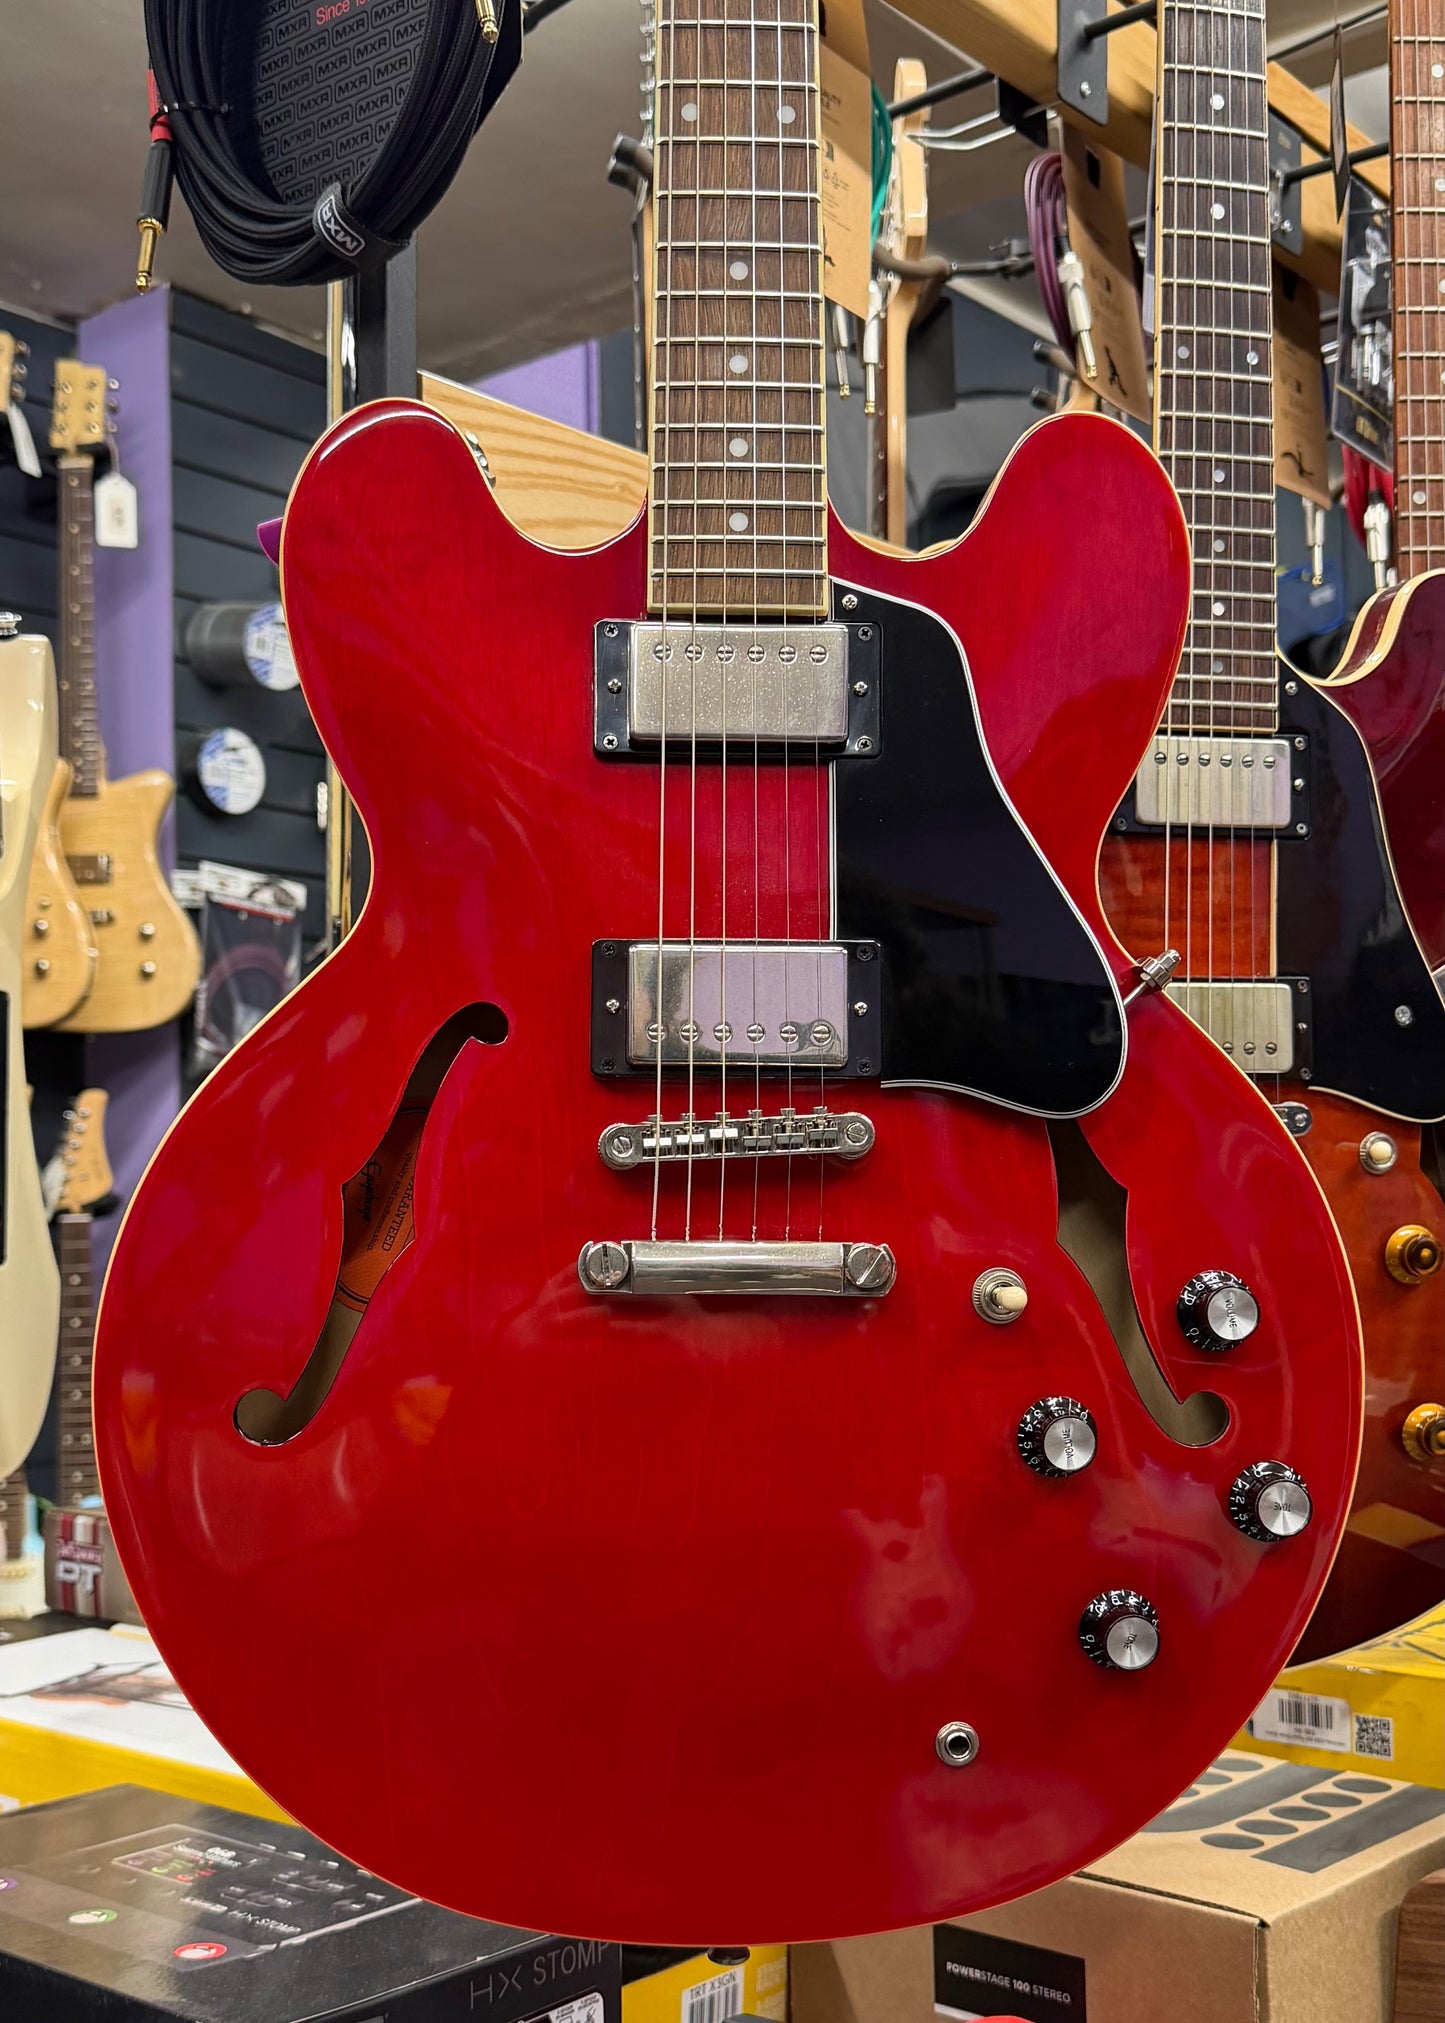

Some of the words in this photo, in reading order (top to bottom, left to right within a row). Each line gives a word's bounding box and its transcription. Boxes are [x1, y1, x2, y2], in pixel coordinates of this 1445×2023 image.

[315, 2, 350, 25] Since
[374, 2, 406, 23] MXR
[278, 16, 308, 37] MXR
[335, 18, 366, 41] MXR
[297, 36, 327, 59] MXR
[356, 36, 388, 60] MXR
[261, 54, 291, 76] MXR
[318, 54, 348, 78] MXR
[376, 56, 408, 80] MXR
[281, 72, 311, 95] MXR
[337, 73, 369, 97] MXR
[256, 89, 274, 105] XR
[301, 92, 330, 113] MXR
[357, 93, 389, 116] MXR
[264, 108, 292, 131] MXR
[320, 110, 350, 133] MXR
[339, 130, 370, 154] MXR
[301, 147, 331, 170] MXR
[285, 182, 313, 203] MXR
[322, 202, 358, 251] MXR
[1225, 1299, 1238, 1329] VOLUME
[1023, 1441, 1034, 1449] 5
[1062, 1428, 1074, 1459] VOLUME
[1235, 1495, 1246, 1505] 2
[469, 1963, 522, 2012] HX
[533, 1941, 609, 1986] STOMP
[945, 1960, 1011, 1988] POWERSTAGE
[1012, 1978, 1031, 1993] 100
[1032, 1984, 1072, 2004] STEREO
